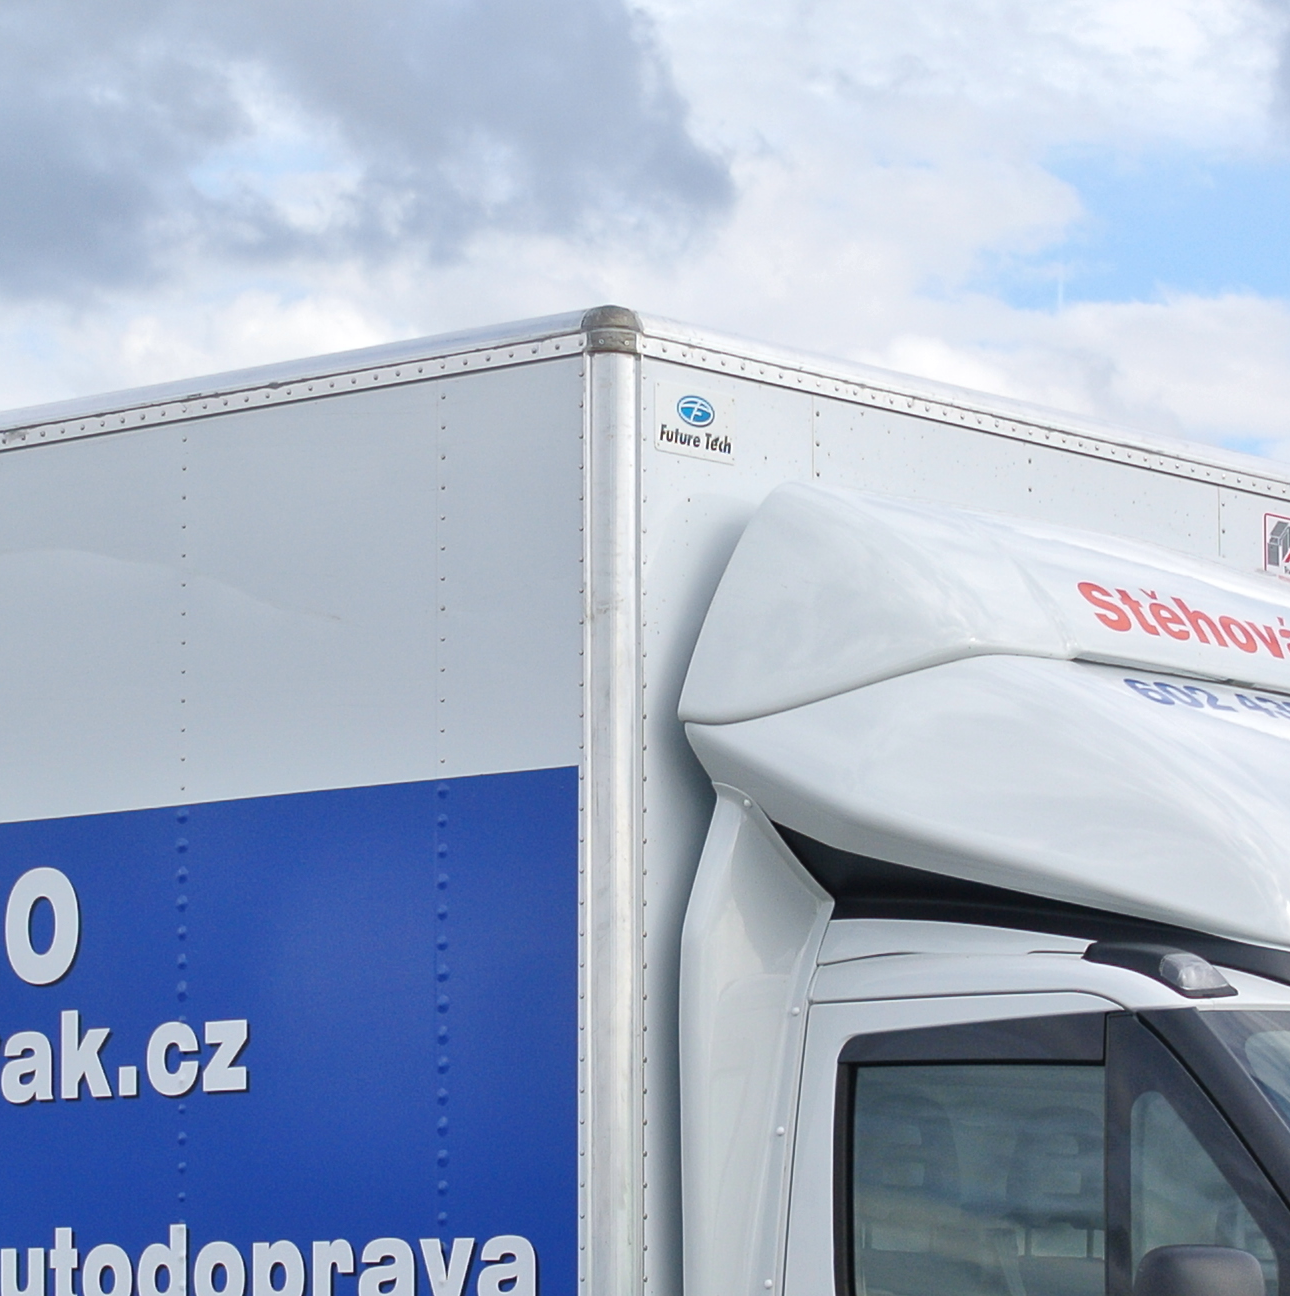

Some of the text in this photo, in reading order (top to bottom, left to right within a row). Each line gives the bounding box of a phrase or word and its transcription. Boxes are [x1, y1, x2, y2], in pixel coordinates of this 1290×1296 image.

[659, 423, 732, 454] Future Tech
[1123, 678, 1238, 713] 602
